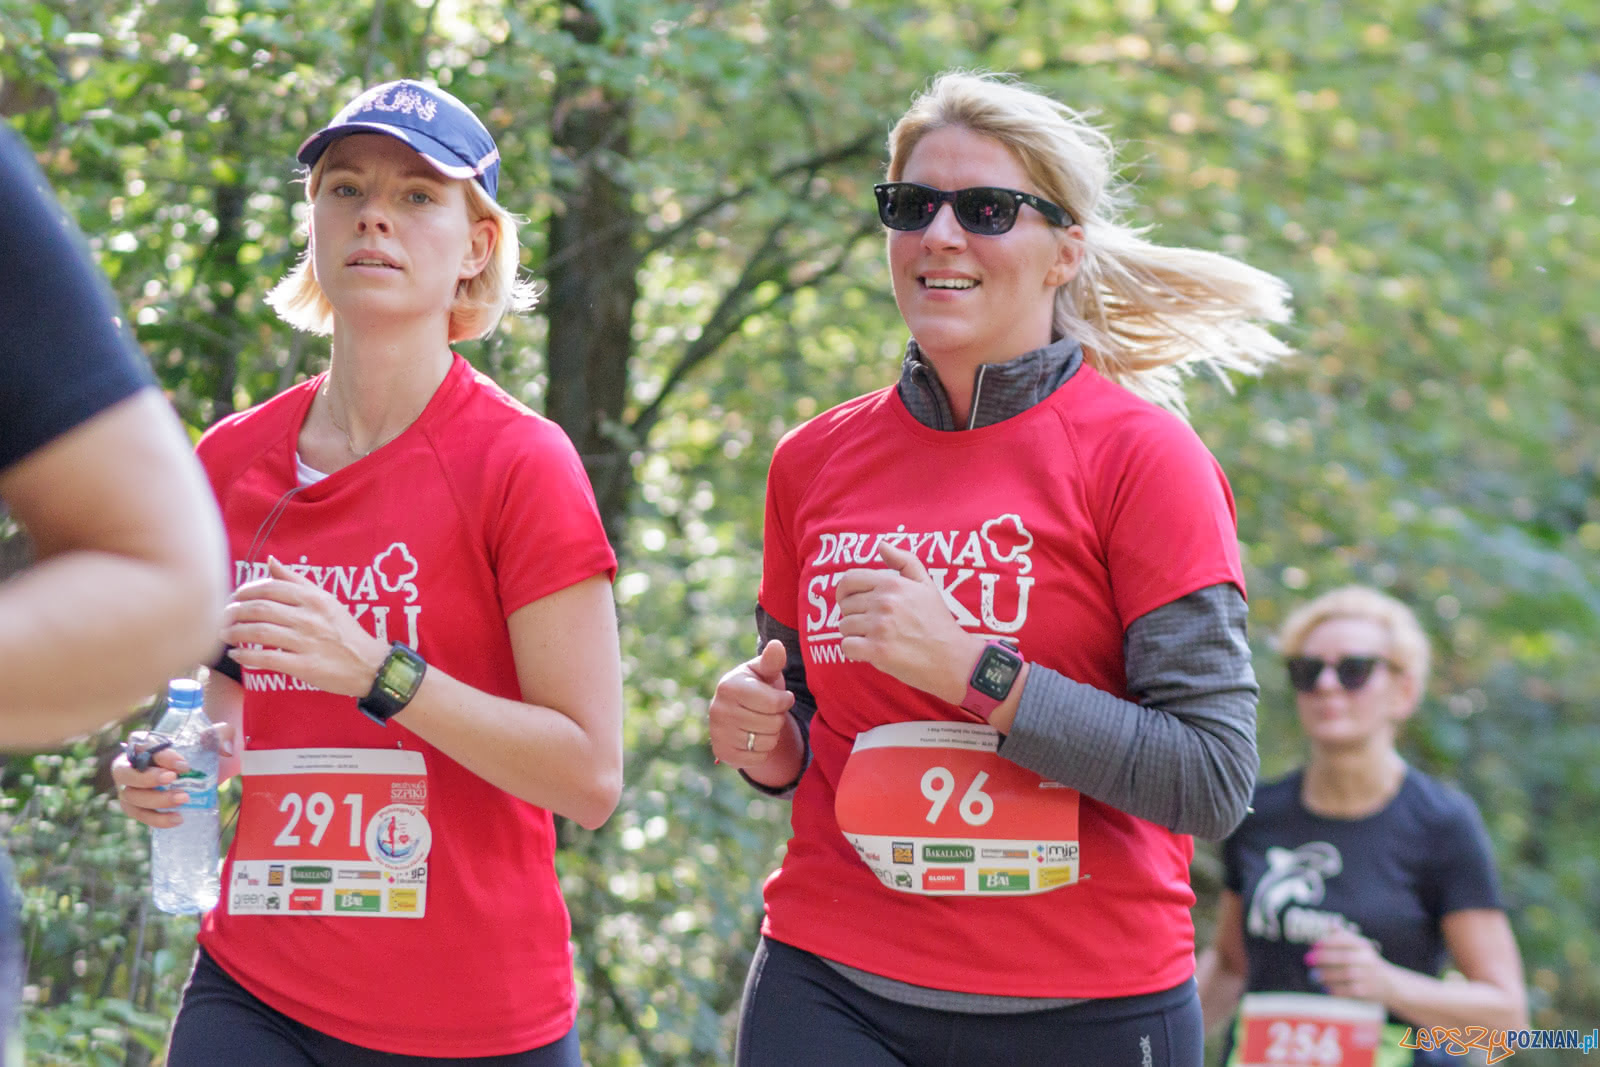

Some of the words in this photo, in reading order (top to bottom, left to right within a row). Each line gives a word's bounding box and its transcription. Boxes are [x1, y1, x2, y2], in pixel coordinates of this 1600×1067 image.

[274, 791, 363, 847] 291
[920, 766, 994, 827] 96
[925, 847, 972, 858] BAKALLAND
